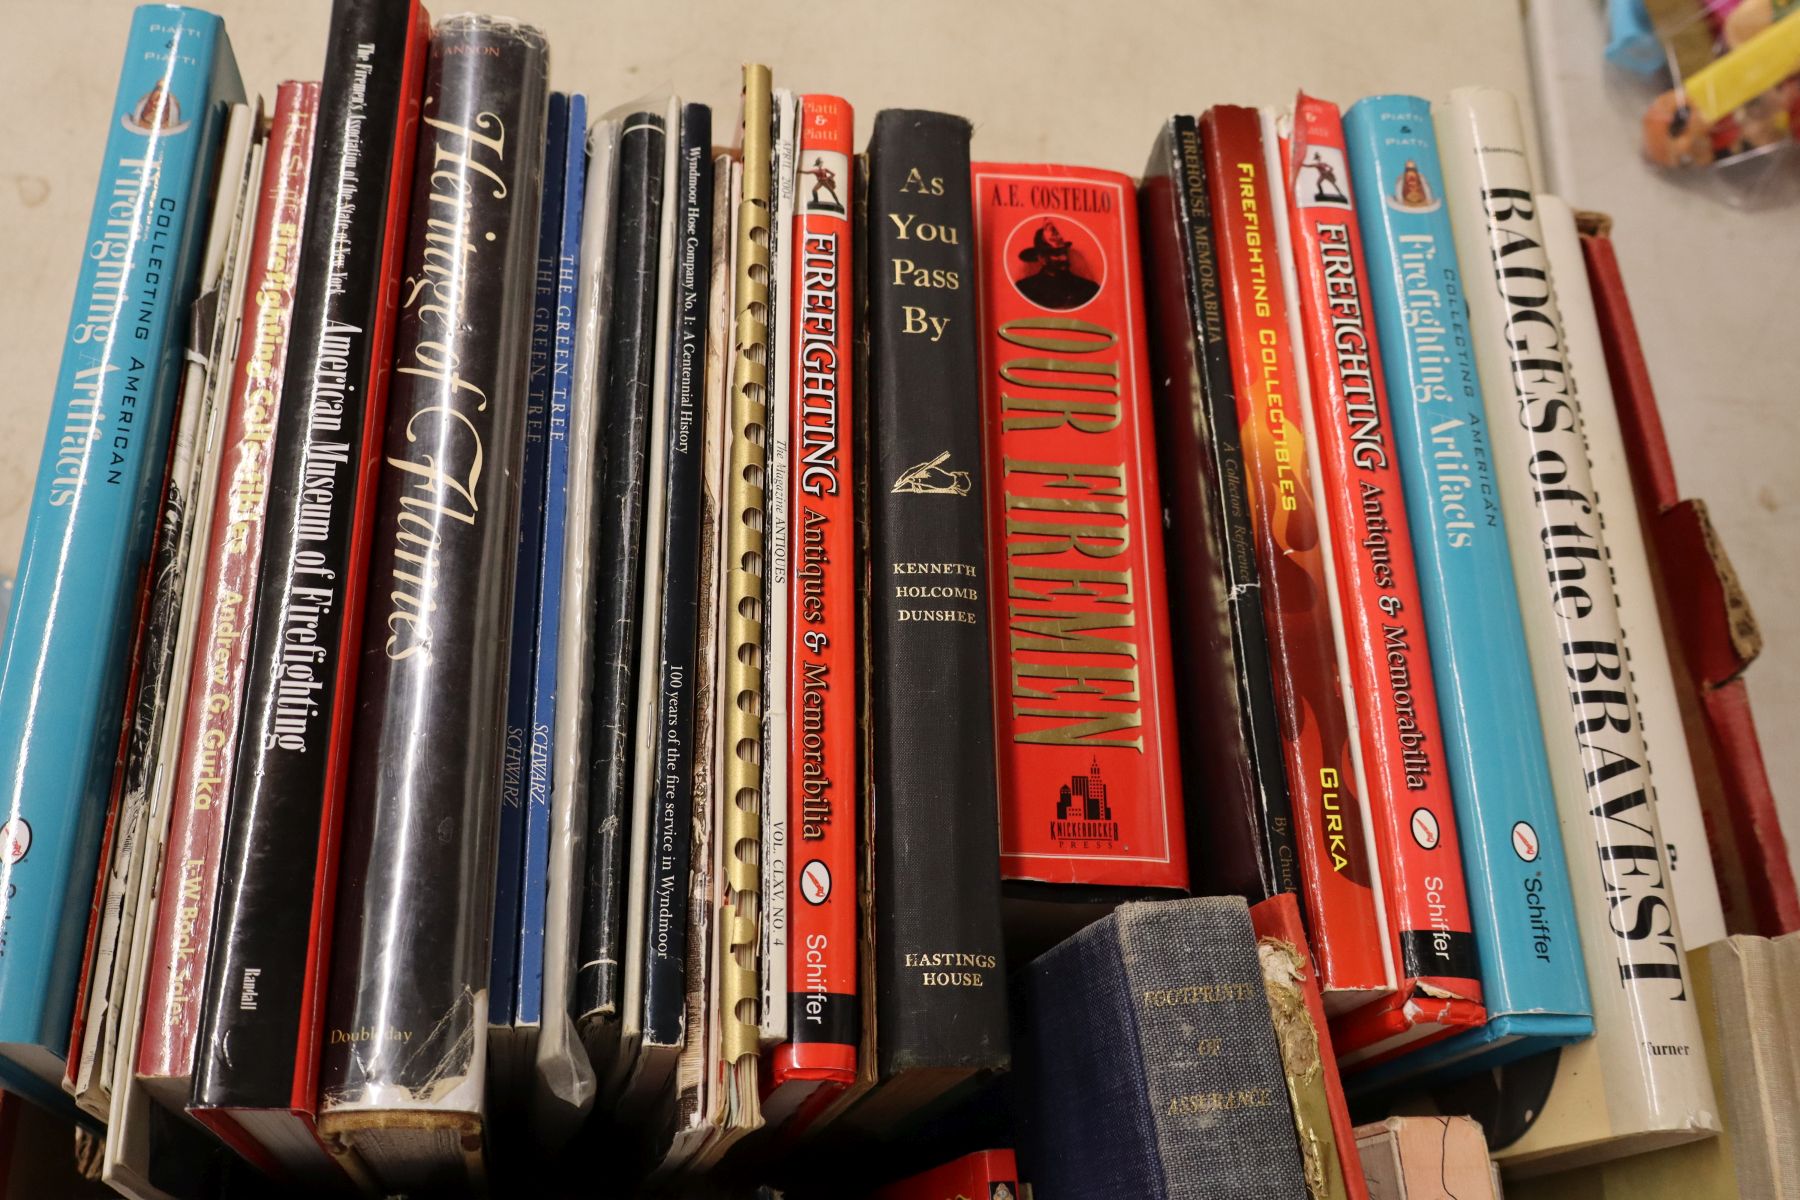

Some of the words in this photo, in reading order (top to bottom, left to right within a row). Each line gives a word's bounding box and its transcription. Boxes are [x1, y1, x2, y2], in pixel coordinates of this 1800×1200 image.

[357, 43, 376, 60] The
[347, 63, 374, 111] Firemen's
[342, 115, 368, 168] Association
[815, 115, 828, 126] &
[339, 184, 358, 200] the
[341, 170, 359, 182] of
[686, 146, 702, 206] Wyndmoor
[900, 167, 945, 196] As
[338, 203, 357, 229] State
[687, 207, 700, 234] Hose
[992, 184, 1024, 208] A.E.
[1030, 185, 1111, 214] COSTELLO
[335, 231, 352, 244] of
[888, 213, 959, 245] You
[1182, 130, 1206, 217] FIREHOUSE
[1194, 225, 1223, 345] MEMORABILIA
[134, 197, 176, 341] COLLECTING
[332, 248, 351, 269] New
[537, 256, 553, 295] THE
[559, 254, 574, 294] THE
[682, 236, 699, 292] Company
[892, 258, 960, 290] Pass
[327, 272, 348, 296] York
[684, 292, 697, 312] No.
[902, 306, 951, 342] By
[1481, 188, 1576, 434] BADGES
[531, 307, 549, 378] GREEN
[554, 305, 572, 375] GREEN
[683, 331, 696, 341] A
[1237, 162, 1270, 318] FIREFIGHTING
[1258, 329, 1297, 511] COLLECTIBLES
[1316, 221, 1388, 472] FIREFIGHTING
[311, 318, 363, 431] American
[398, 341, 487, 413] of
[680, 343, 696, 407] Centennial
[801, 232, 838, 498] FIREFIGHTING
[999, 317, 1122, 434] OUR
[1398, 234, 1453, 404] Firefighting
[1427, 408, 1475, 549] Artifacts
[1444, 268, 1475, 399] COLLECTING
[1467, 412, 1497, 528] AMERICAN
[107, 356, 145, 485] AMERICAN
[527, 390, 545, 443] TREE
[550, 388, 567, 441] TREE
[675, 410, 693, 454] History
[776, 440, 787, 460] The
[1223, 441, 1235, 452] A
[297, 440, 350, 541] Museum
[774, 463, 787, 514] Magazine
[1528, 449, 1592, 515] of
[774, 516, 787, 584] ANTIQUES
[1359, 480, 1393, 588] Antiques
[293, 550, 335, 580] of
[797, 506, 829, 622] Antiques
[893, 563, 977, 577] KENNETH
[1540, 520, 1601, 620] the
[895, 586, 978, 600] HOLCOMB
[1003, 454, 1144, 755] FIREMEN
[1377, 594, 1401, 616] &
[213, 590, 243, 687] Andrew
[898, 610, 977, 624] DUNSHEE
[802, 630, 828, 653] &
[264, 586, 335, 753] Firefighting
[669, 664, 684, 689] 100
[206, 691, 231, 722] G.
[665, 690, 680, 726] years
[1382, 623, 1428, 791] Memorabilia
[666, 747, 681, 771] the
[667, 729, 681, 746] of
[802, 662, 831, 842] Memorabilia
[194, 728, 226, 812] Gurka
[503, 725, 523, 809] SCHWARZ
[530, 722, 549, 805] SCHWARZ
[665, 775, 680, 799] fire
[662, 802, 677, 852] service
[772, 821, 785, 854] VOL.
[1050, 821, 1119, 842] KNICKERBOCKER
[1272, 817, 1287, 836] By
[1319, 767, 1349, 873] GURKA
[1561, 640, 1687, 1002] BRAVEST
[662, 855, 676, 870] in
[1059, 841, 1113, 849] PRESS
[771, 858, 785, 902] CLXV,
[177, 906, 200, 961] Book
[656, 875, 675, 959] Wyndmoor
[772, 906, 785, 932] NO.
[1424, 876, 1451, 961] Schiffer
[1523, 877, 1553, 964] Schiffer
[773, 938, 785, 946] 4
[905, 953, 997, 969] HASTINGS
[240, 968, 262, 1010] Randall
[806, 934, 828, 1025] Schiffer
[923, 972, 983, 987] HOUSE
[1642, 1040, 1692, 1057] Turner
